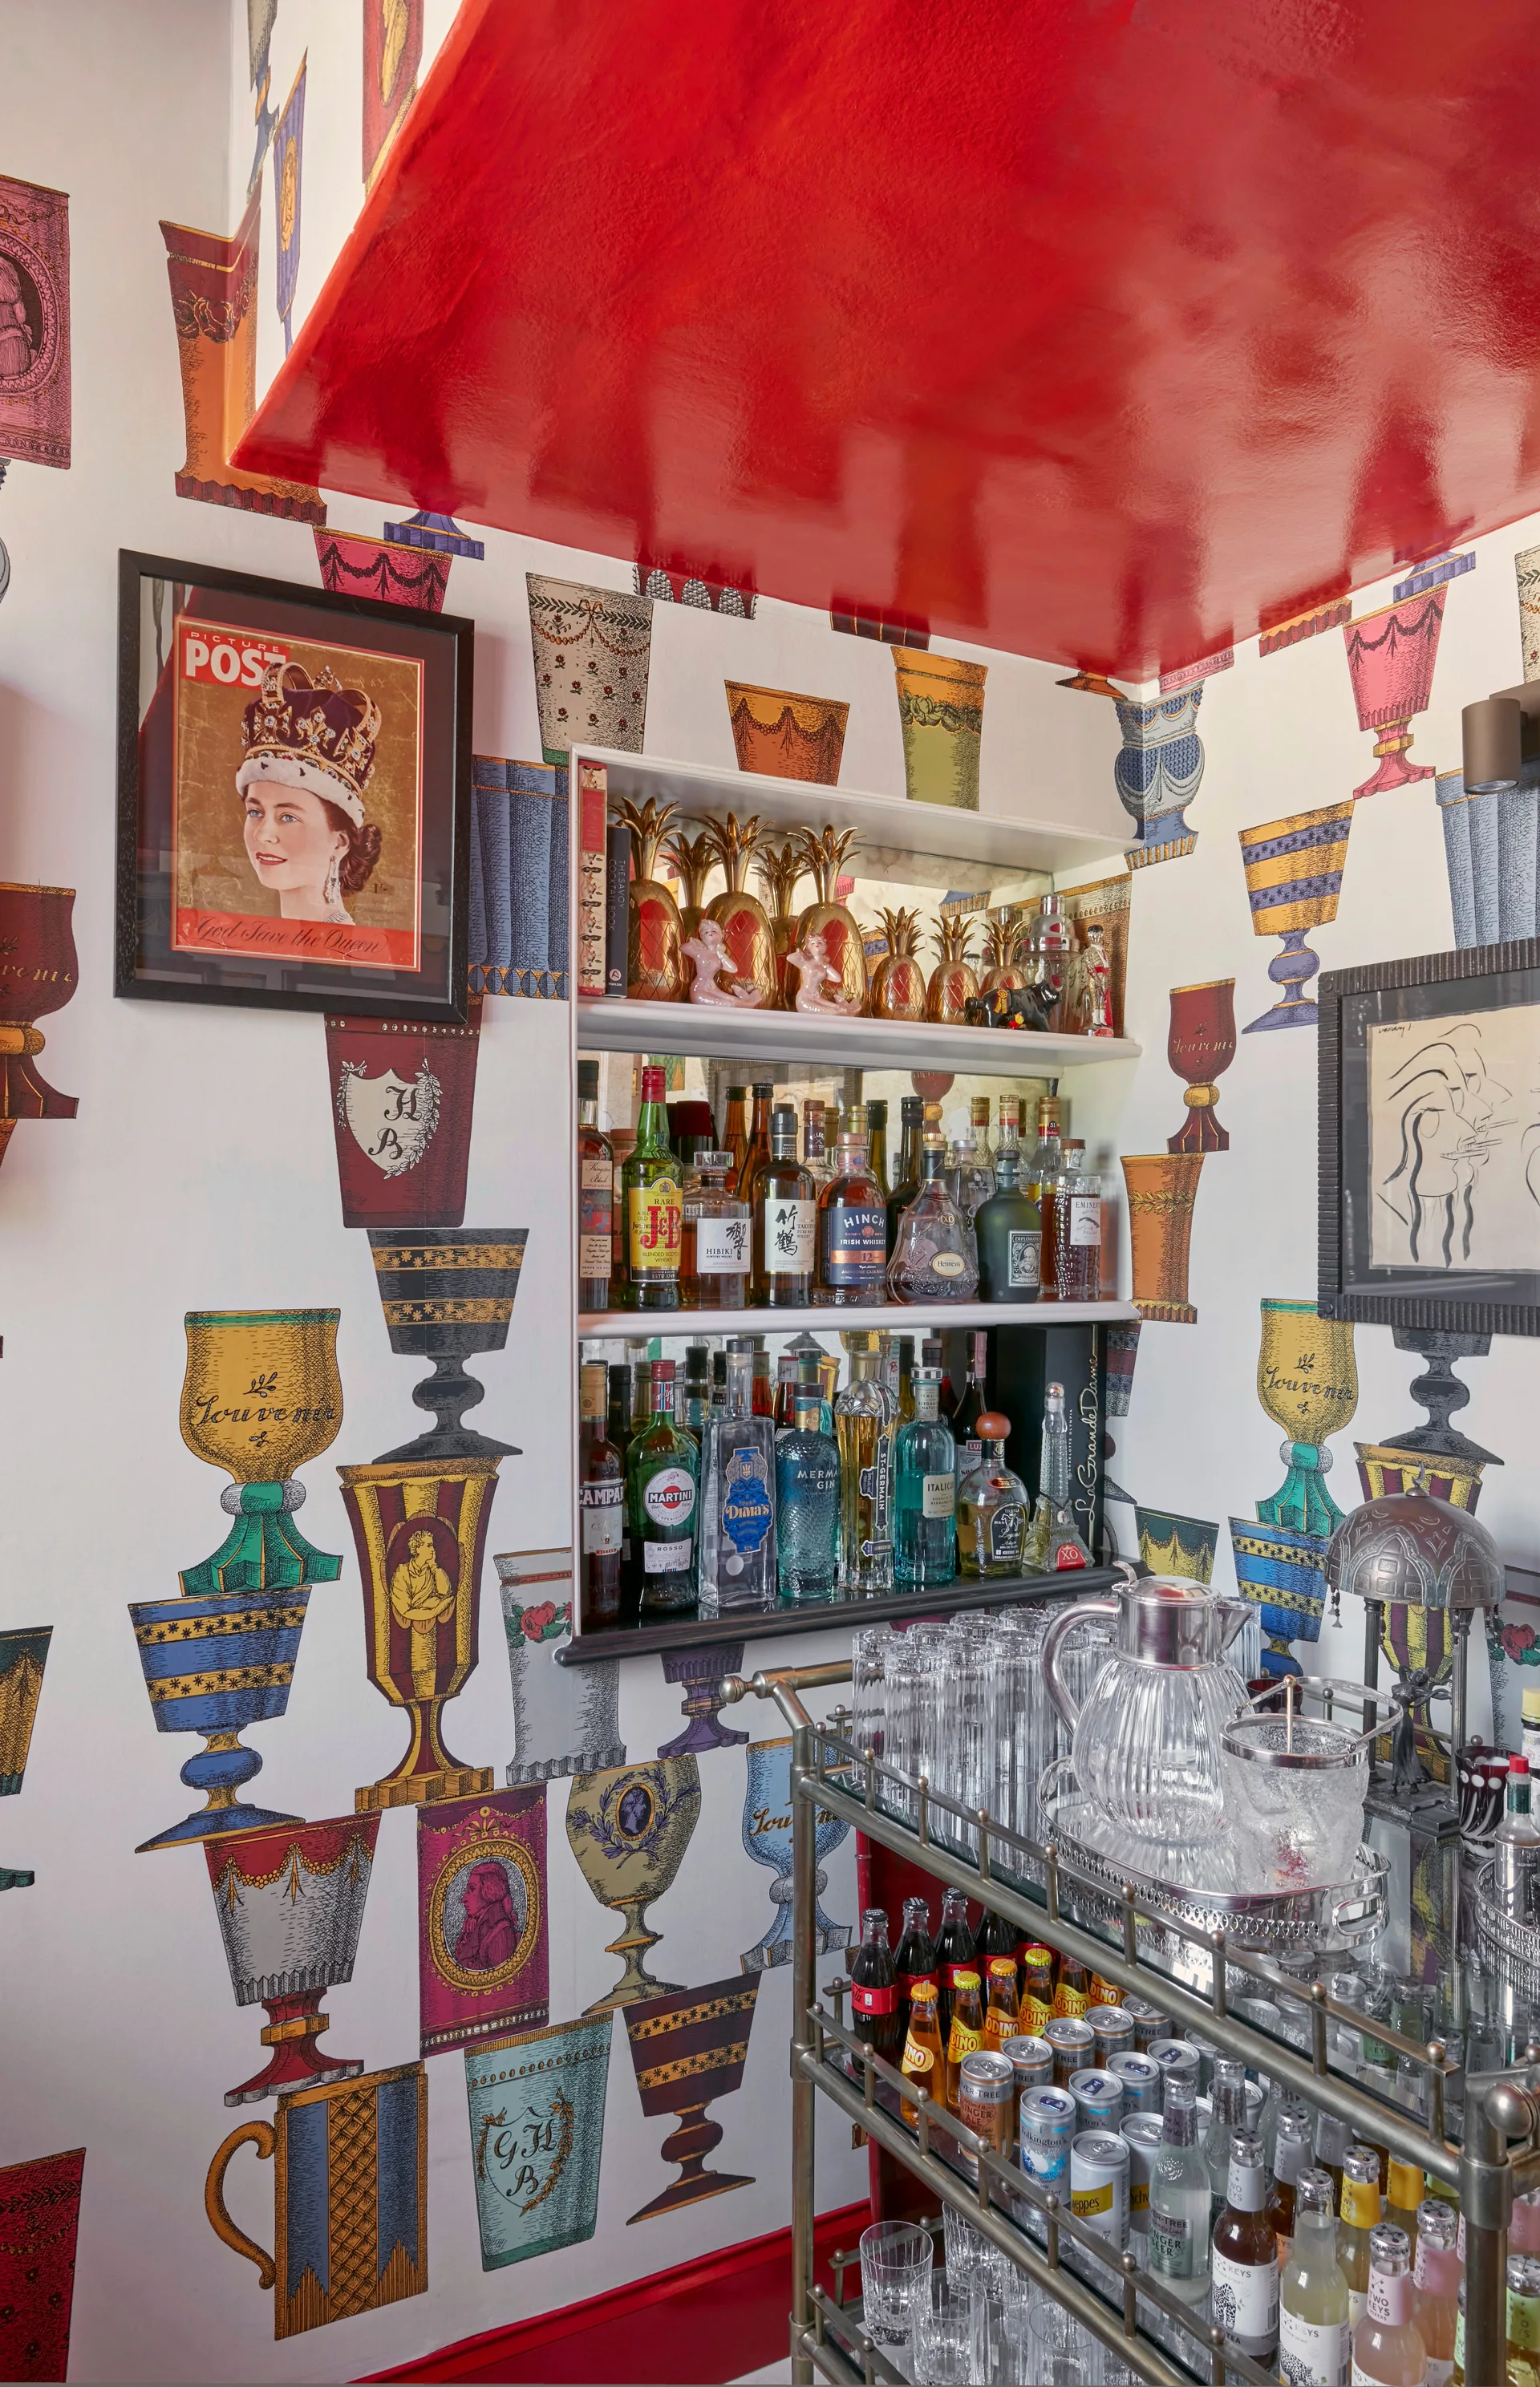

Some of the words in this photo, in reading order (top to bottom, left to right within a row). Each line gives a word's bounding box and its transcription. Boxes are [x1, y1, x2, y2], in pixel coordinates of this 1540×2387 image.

[190, 631, 279, 653] PICTURE
[618, 860, 626, 876] THE
[608, 859, 617, 902] COCKTAIL
[618, 877, 626, 909] SAVOY
[607, 906, 616, 930] BOOK
[197, 916, 240, 949] God
[241, 922, 289, 946] Save
[290, 928, 322, 948] the
[323, 928, 388, 961] Queen
[639, 1206, 681, 1250] J&B
[844, 1214, 885, 1229] HINCH
[861, 1252, 873, 1262] 12
[937, 1260, 961, 1268] Hennessy
[1266, 1364, 1356, 1401] Souvenir
[192, 1394, 336, 1427] Souvenir
[817, 1479, 835, 1489] GIN
[878, 1453, 887, 1510] ST-GERMAIN
[650, 1490, 691, 1503] MARTINI
[1060, 1549, 1079, 1561] XO
[966, 2114, 982, 2126] ALE
[1228, 2265, 1251, 2278] KEYS
[1369, 2290, 1388, 2307] TWO
[1368, 2300, 1390, 2316] KEYS
[1226, 2332, 1241, 2344] TEA
